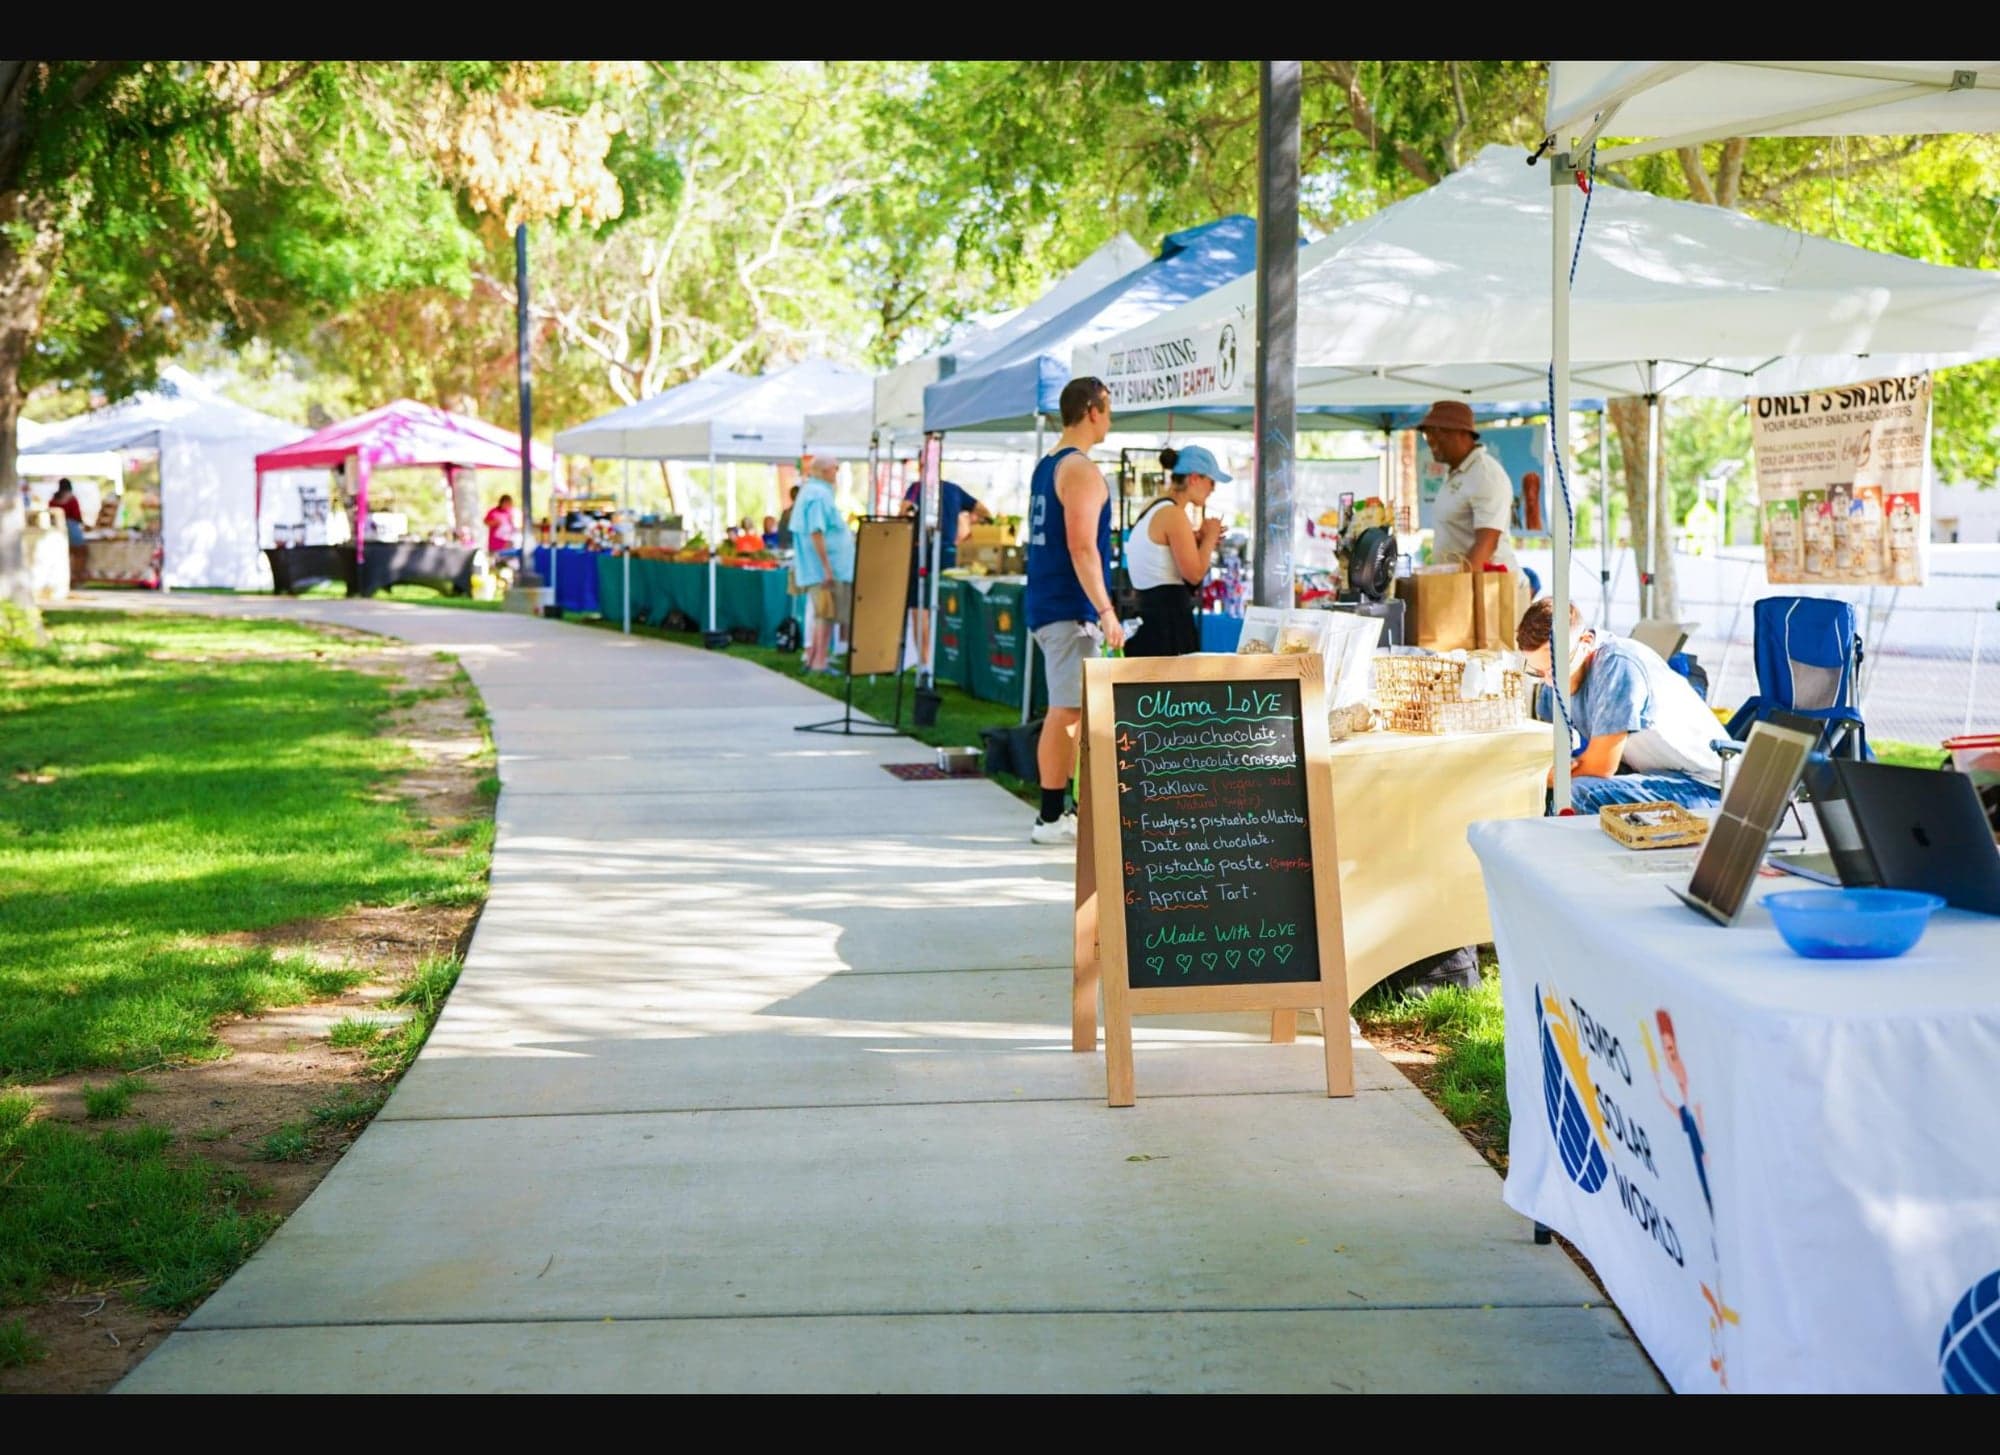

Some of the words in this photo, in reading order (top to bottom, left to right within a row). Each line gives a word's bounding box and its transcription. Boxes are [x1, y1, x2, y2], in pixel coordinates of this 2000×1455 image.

[1127, 377, 1165, 403] SNACKS
[1183, 366, 1216, 396] EARTH
[1757, 395, 1810, 418] ONLY
[1836, 375, 1920, 409] SNACKS
[1763, 421, 1786, 432] YOUR
[1788, 416, 1823, 430] HEALTHY
[1825, 412, 1853, 426] SNACK
[1138, 690, 1216, 718] Mama
[1138, 731, 1197, 752] Dubai
[1135, 755, 1181, 774] Dubai
[1142, 838, 1182, 853] Date
[1185, 838, 1210, 851] and
[1150, 885, 1208, 909] Apricot
[1146, 925, 1206, 949] Made
[1569, 998, 1631, 1086] TEMPO
[1595, 1083, 1659, 1179] SOLAR
[1612, 1161, 1684, 1268] WORLD
